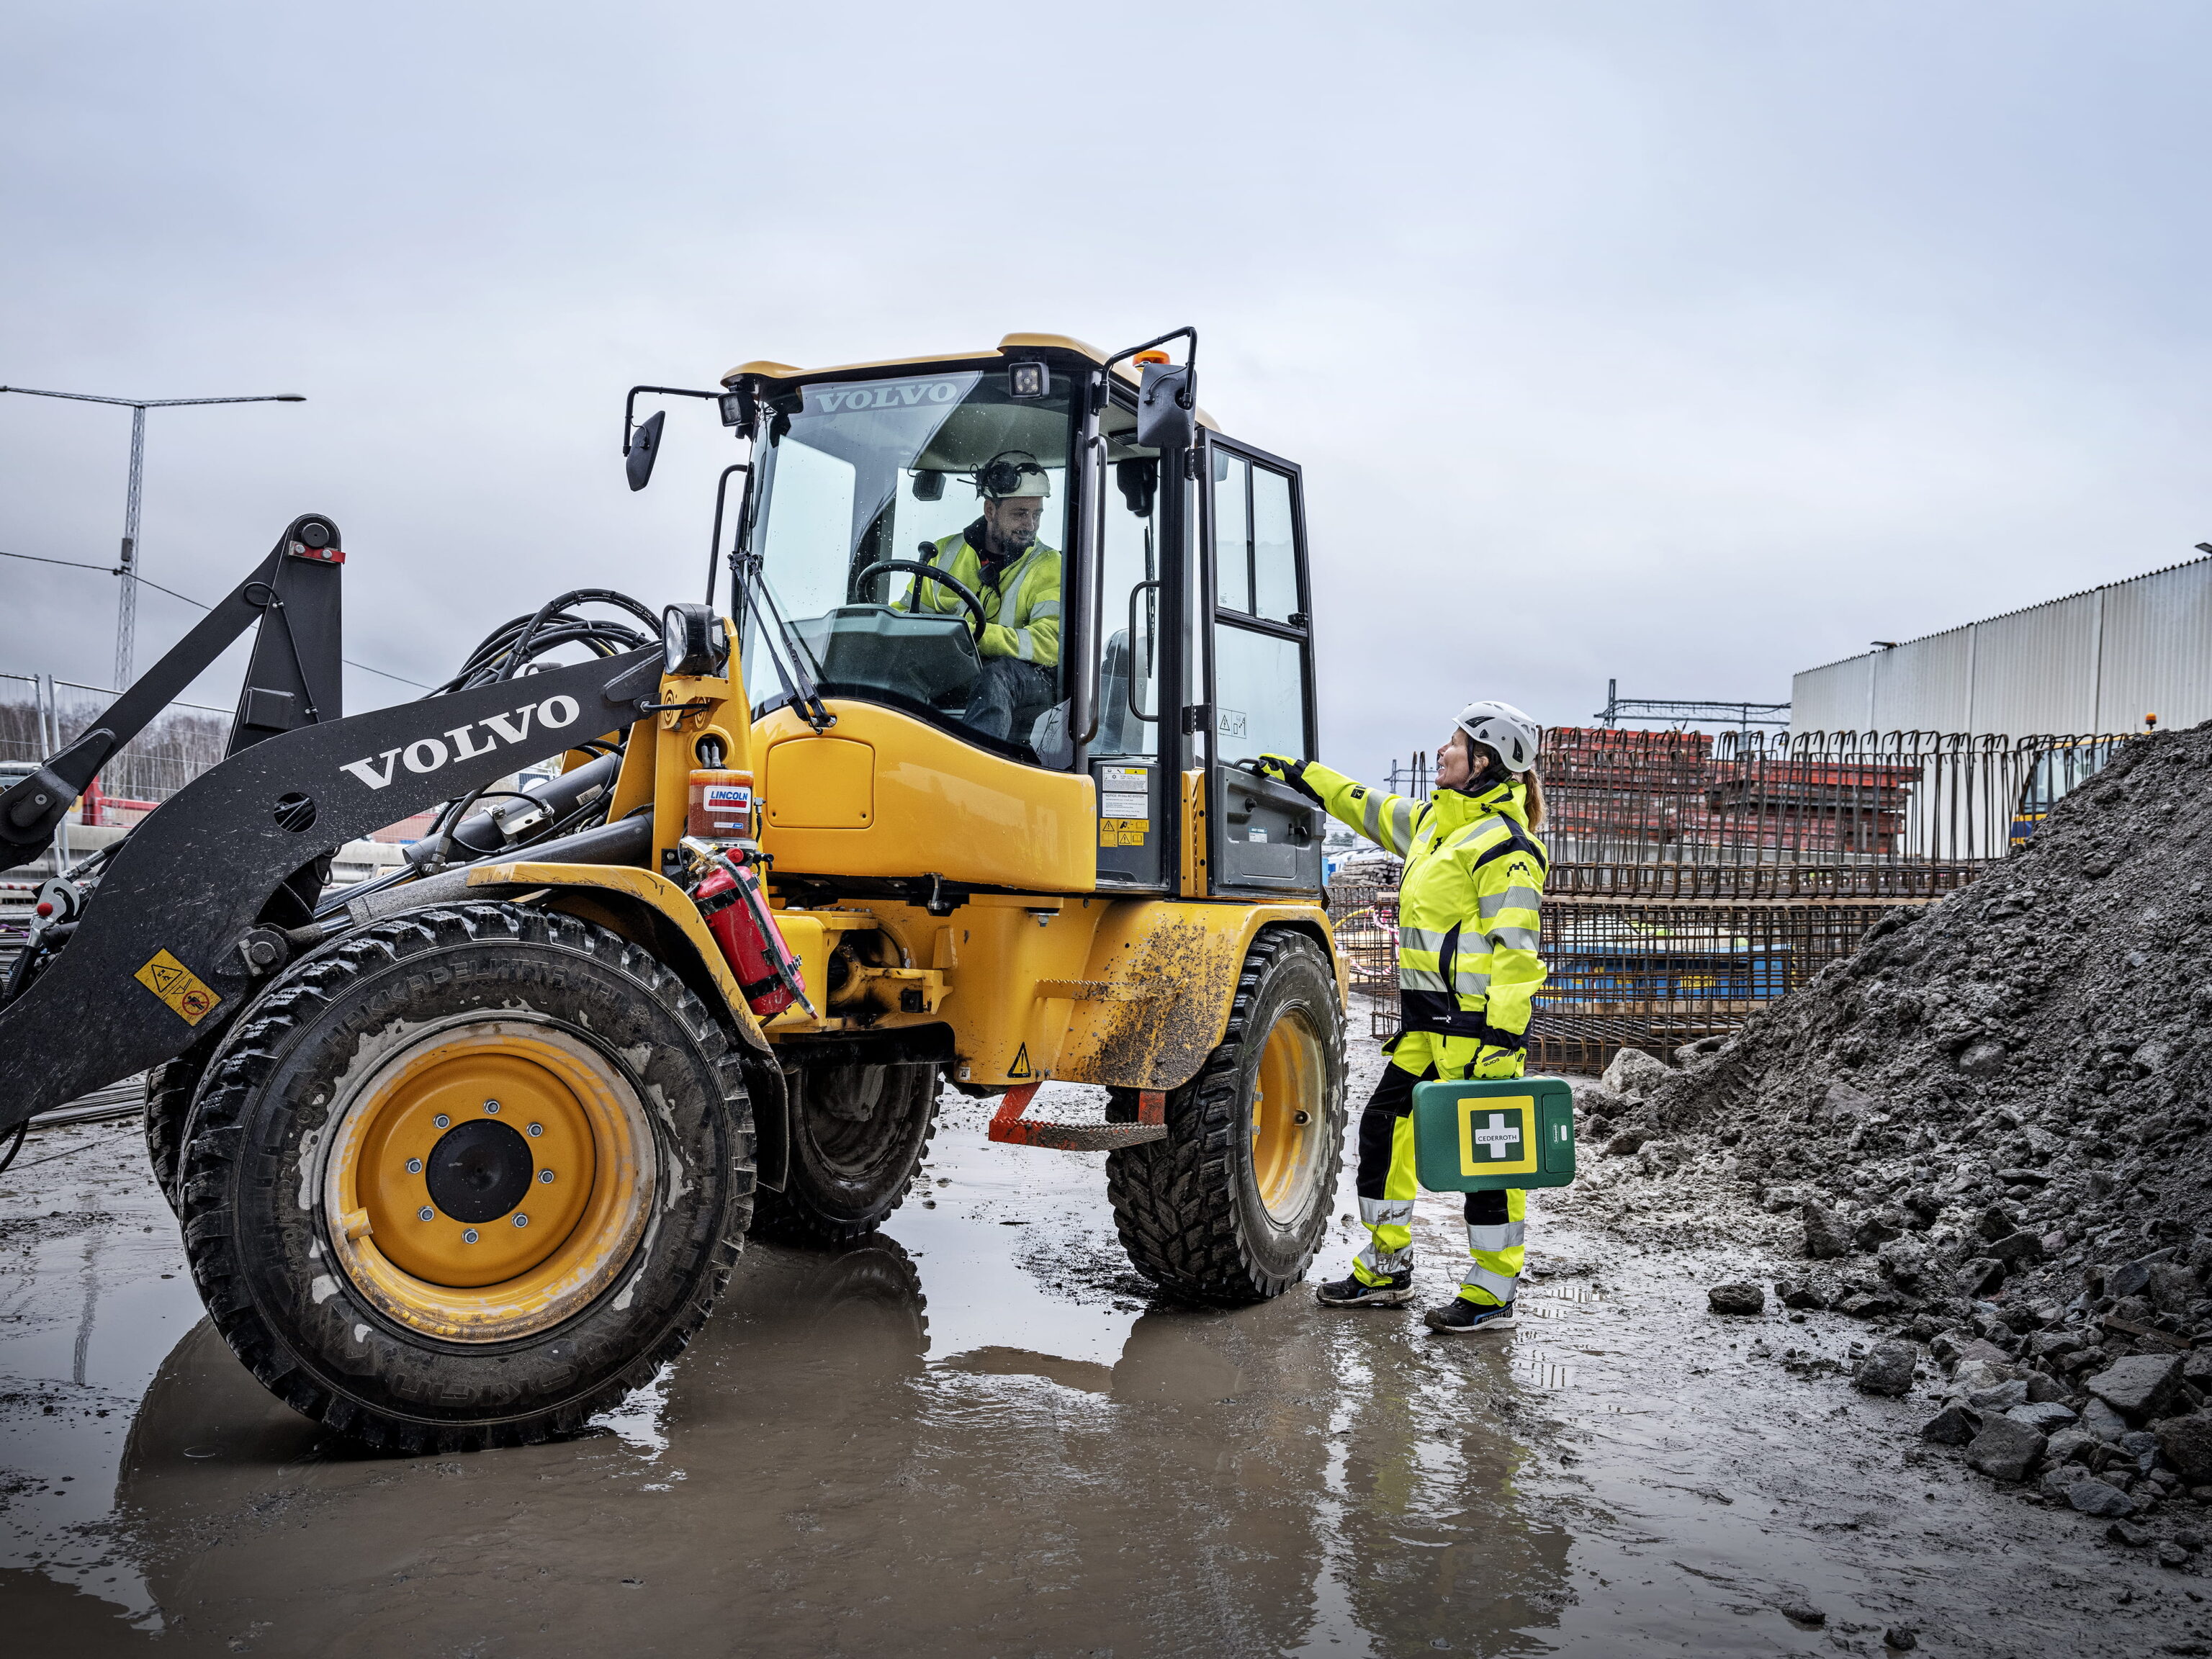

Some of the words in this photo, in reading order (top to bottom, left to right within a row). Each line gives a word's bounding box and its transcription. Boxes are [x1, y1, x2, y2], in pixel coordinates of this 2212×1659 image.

[815, 382, 958, 413] VOLVO
[339, 695, 580, 791] VOLVO
[711, 791, 748, 800] LINCOLN
